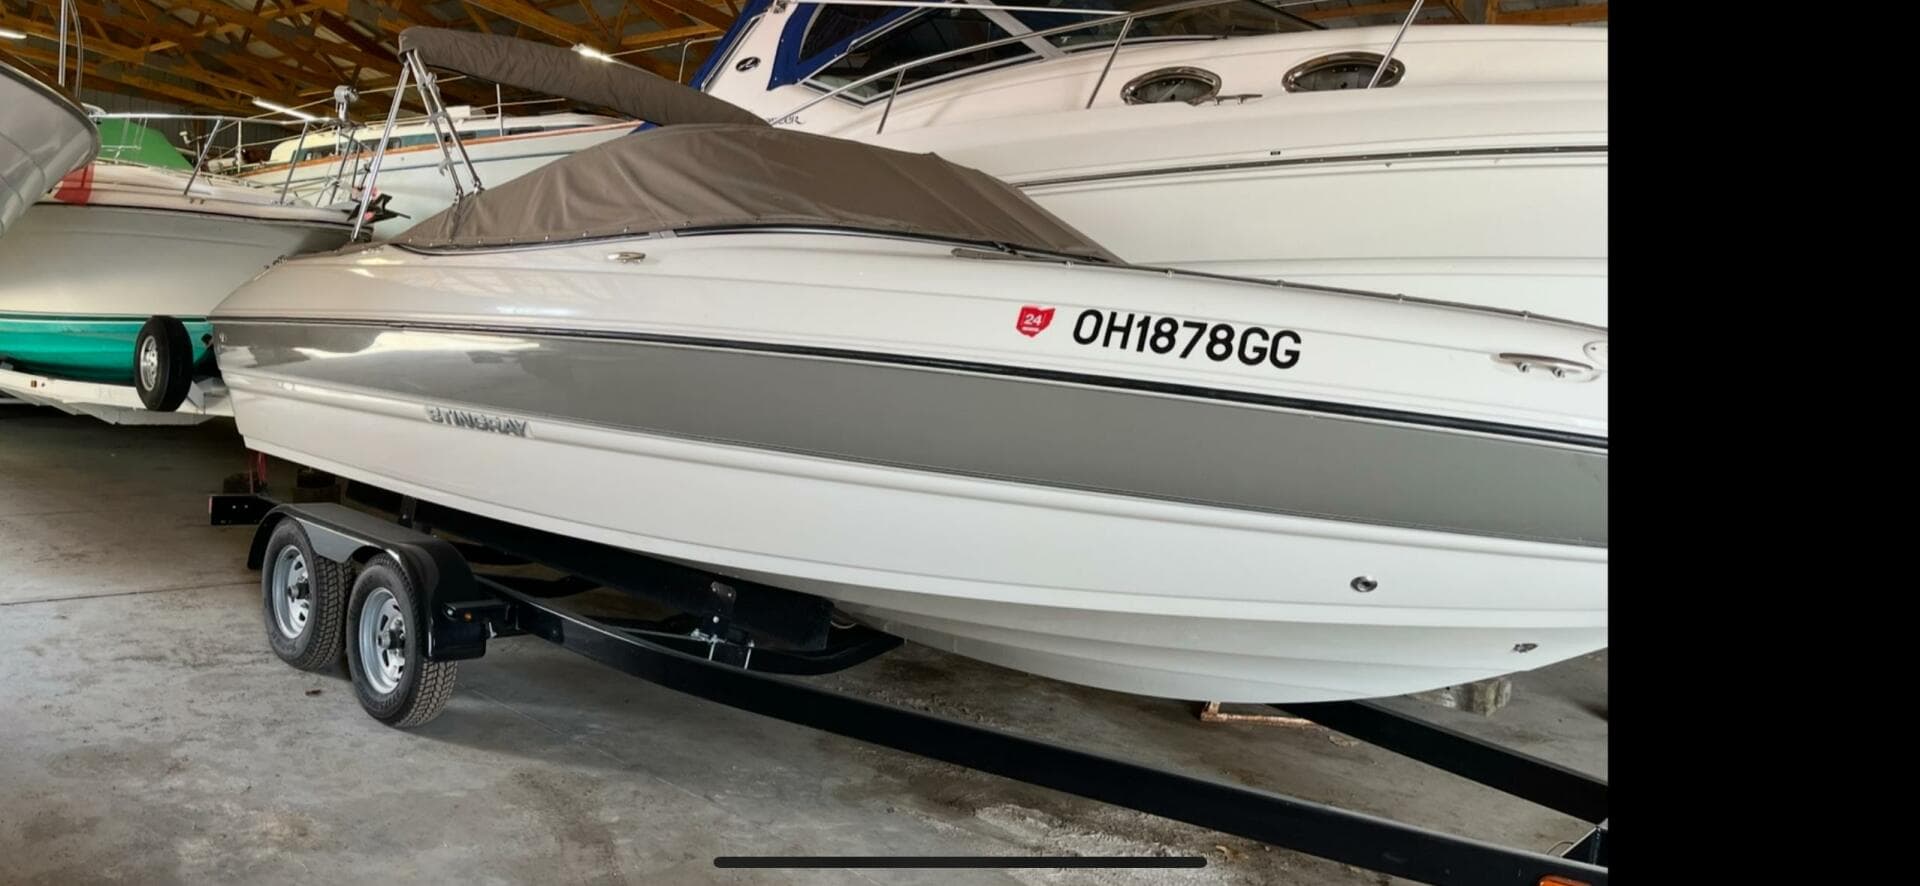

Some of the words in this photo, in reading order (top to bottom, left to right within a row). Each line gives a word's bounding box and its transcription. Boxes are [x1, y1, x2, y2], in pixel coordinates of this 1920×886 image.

[1024, 313, 1042, 326] 24
[1073, 308, 1302, 369] OH1878GG
[427, 406, 530, 438] STINGRAY
